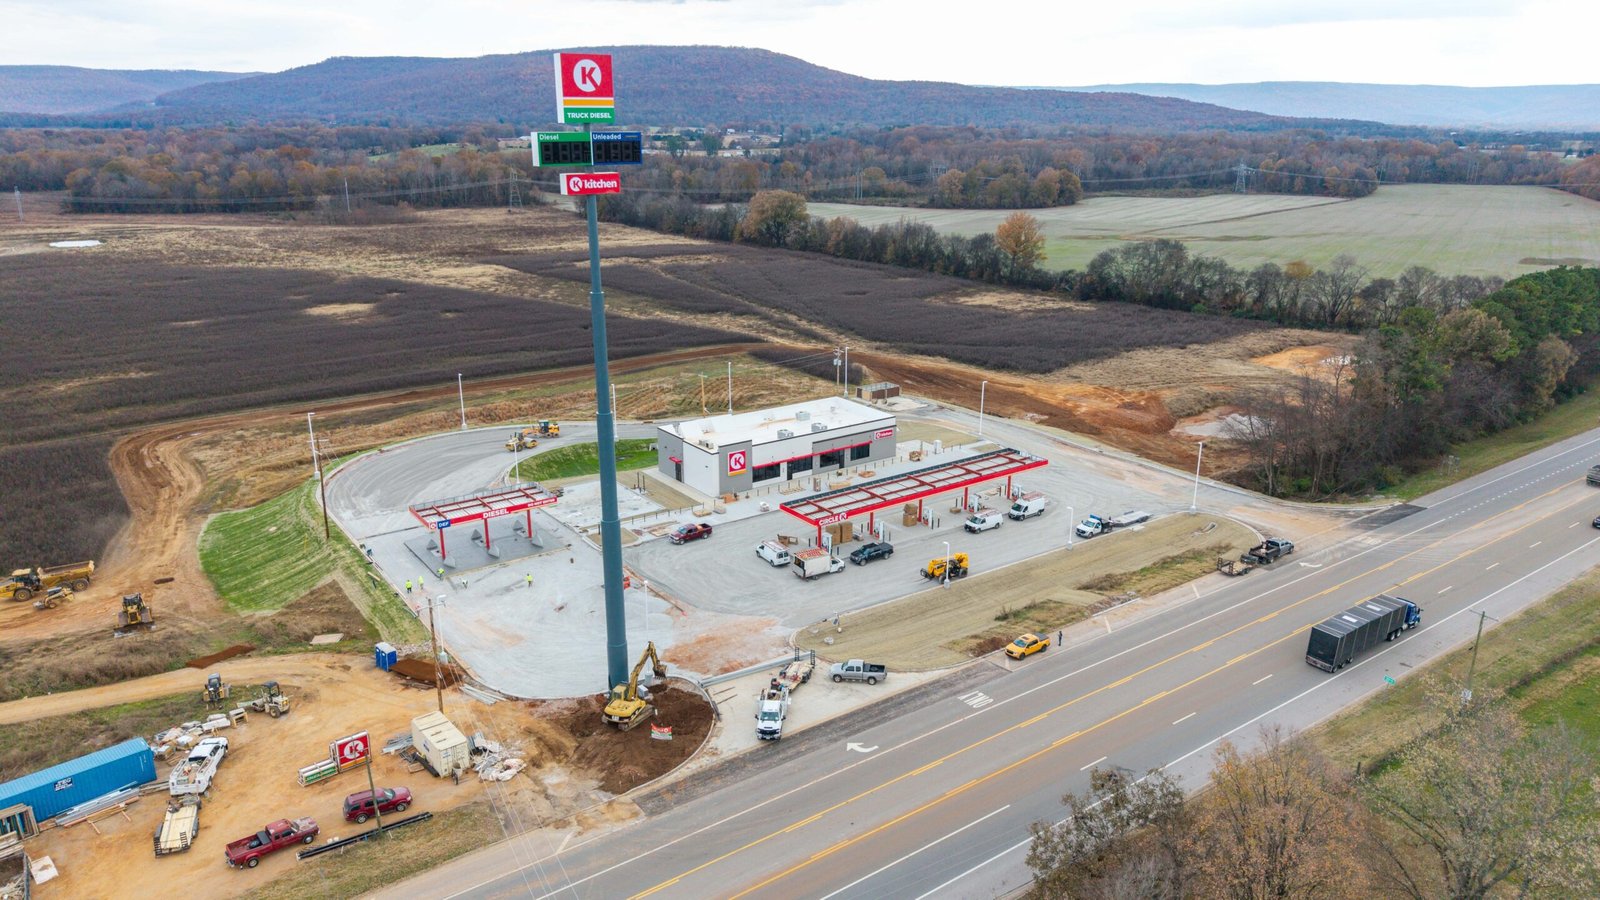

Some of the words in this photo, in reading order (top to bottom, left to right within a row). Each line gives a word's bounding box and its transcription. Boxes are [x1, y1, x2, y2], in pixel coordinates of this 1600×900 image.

[580, 65, 600, 91] K
[571, 179, 582, 191] K
[584, 179, 617, 189] kitchen
[482, 508, 510, 519] DIESEL
[957, 690, 994, 708] ONLY
